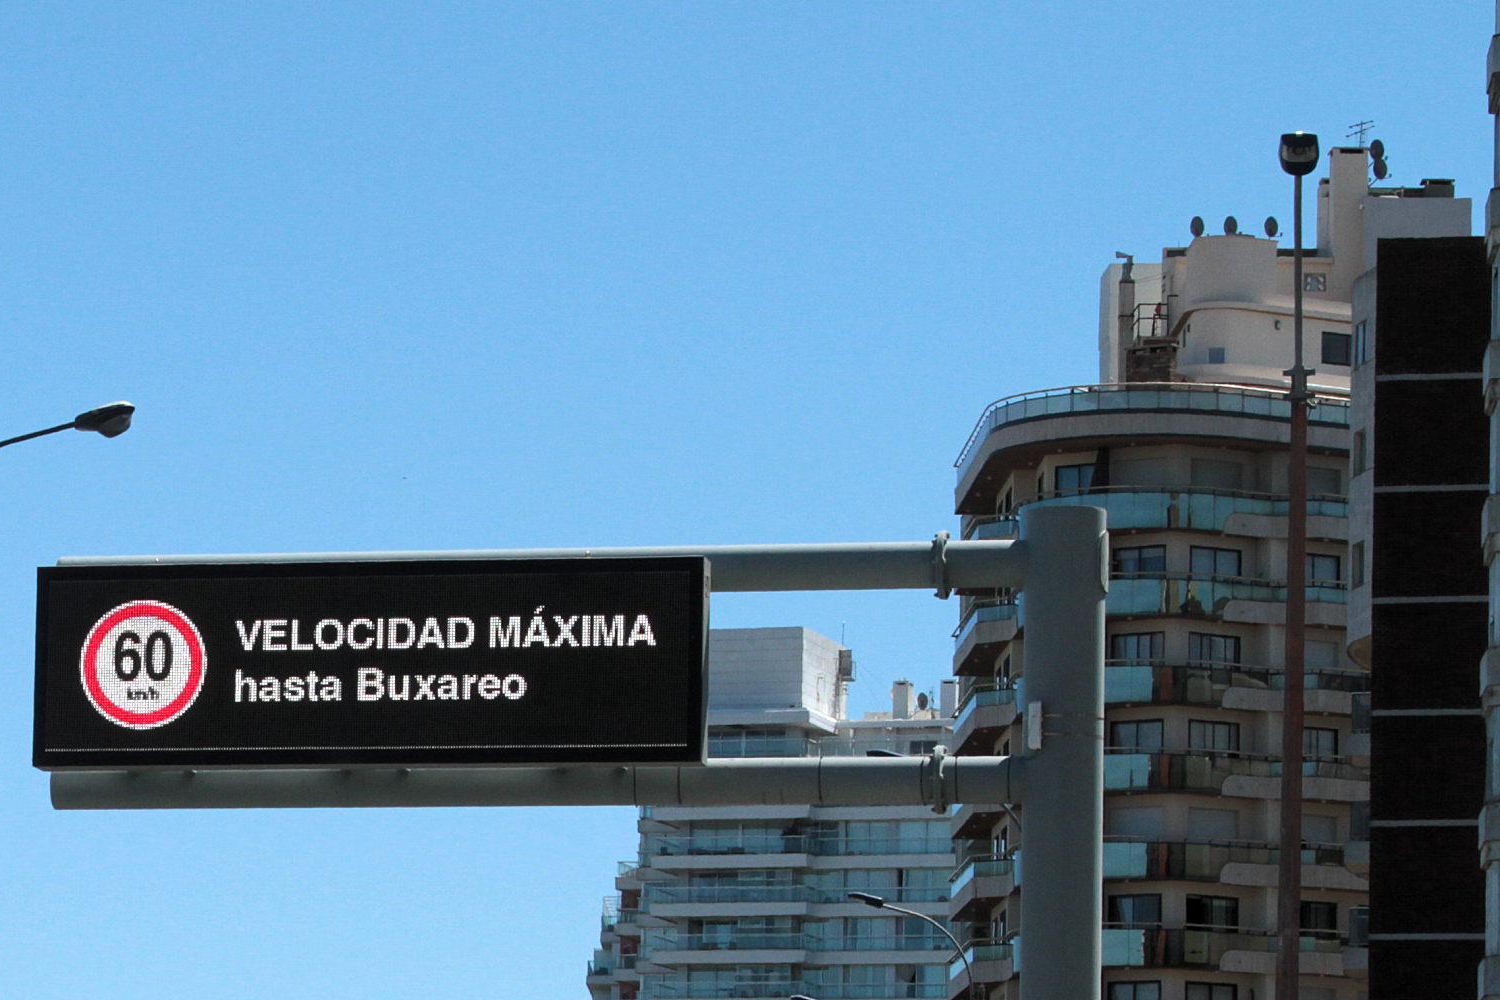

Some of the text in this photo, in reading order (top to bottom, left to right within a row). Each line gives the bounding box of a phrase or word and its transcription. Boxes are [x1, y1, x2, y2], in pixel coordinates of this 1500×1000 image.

[235, 605, 657, 652] VELOCIDAD MÁXIMA
[115, 630, 173, 681] 60
[234, 667, 528, 702] hasta Buxareo
